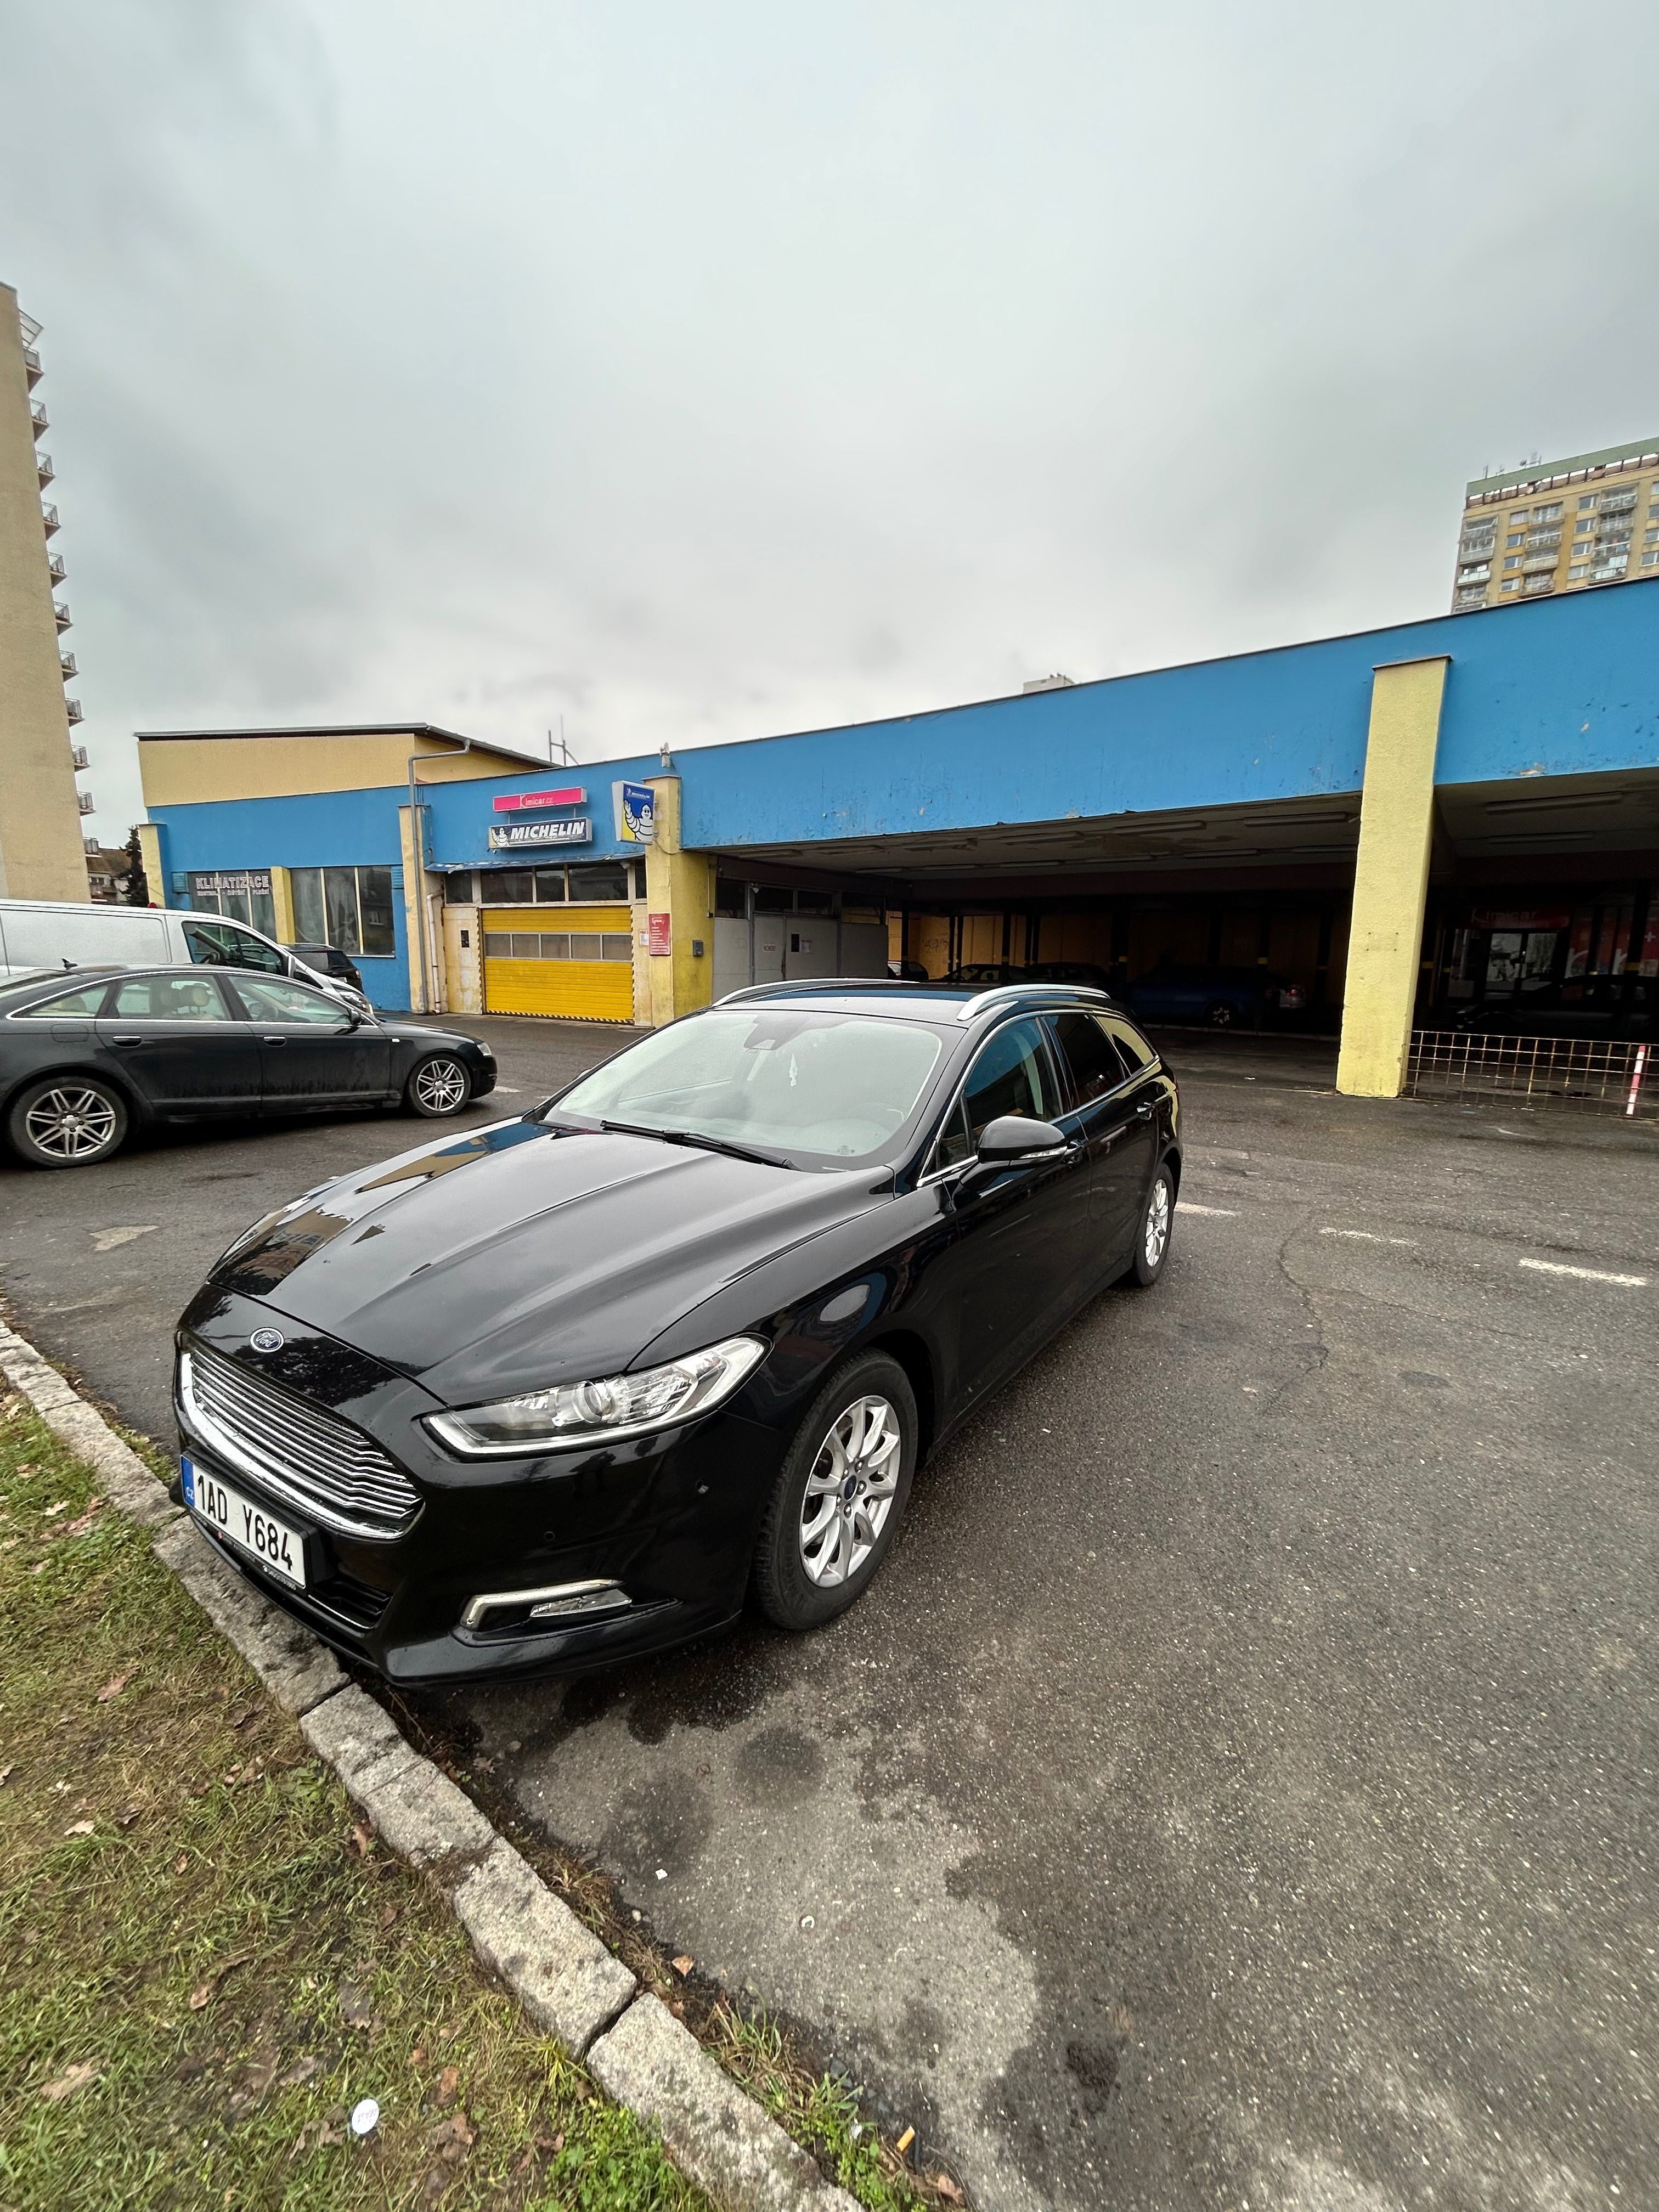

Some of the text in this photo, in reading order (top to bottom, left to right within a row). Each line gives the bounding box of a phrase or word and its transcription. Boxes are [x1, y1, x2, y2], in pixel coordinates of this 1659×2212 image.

[510, 822, 585, 839] MICHELIN
[196, 876, 269, 889] KLIMATIZACE
[256, 1331, 276, 1348] Ford
[198, 1475, 228, 1525] 1AD
[242, 1504, 293, 1571] Y684
